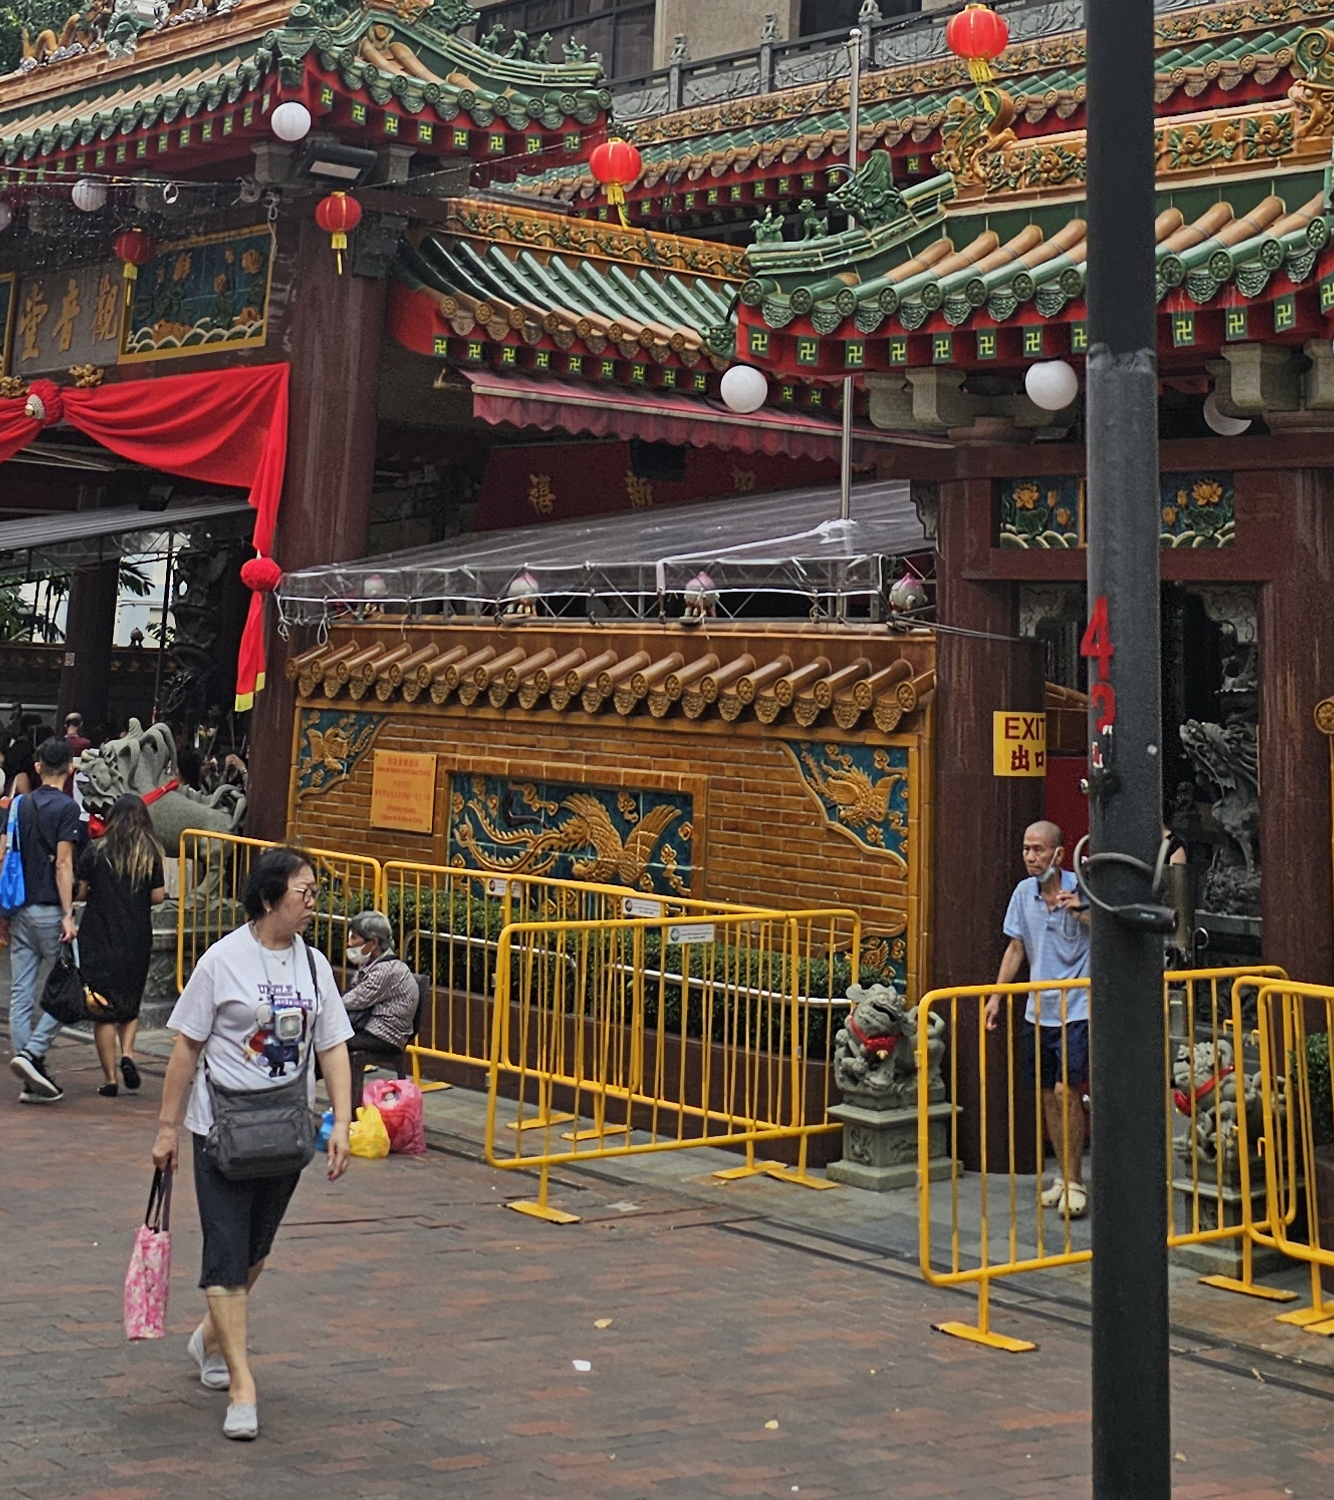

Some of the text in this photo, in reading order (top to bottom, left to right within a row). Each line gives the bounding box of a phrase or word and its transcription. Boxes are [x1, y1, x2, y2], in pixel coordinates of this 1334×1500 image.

[18, 273, 119, 363] 觀音堂
[1010, 744, 1045, 772] 出口
